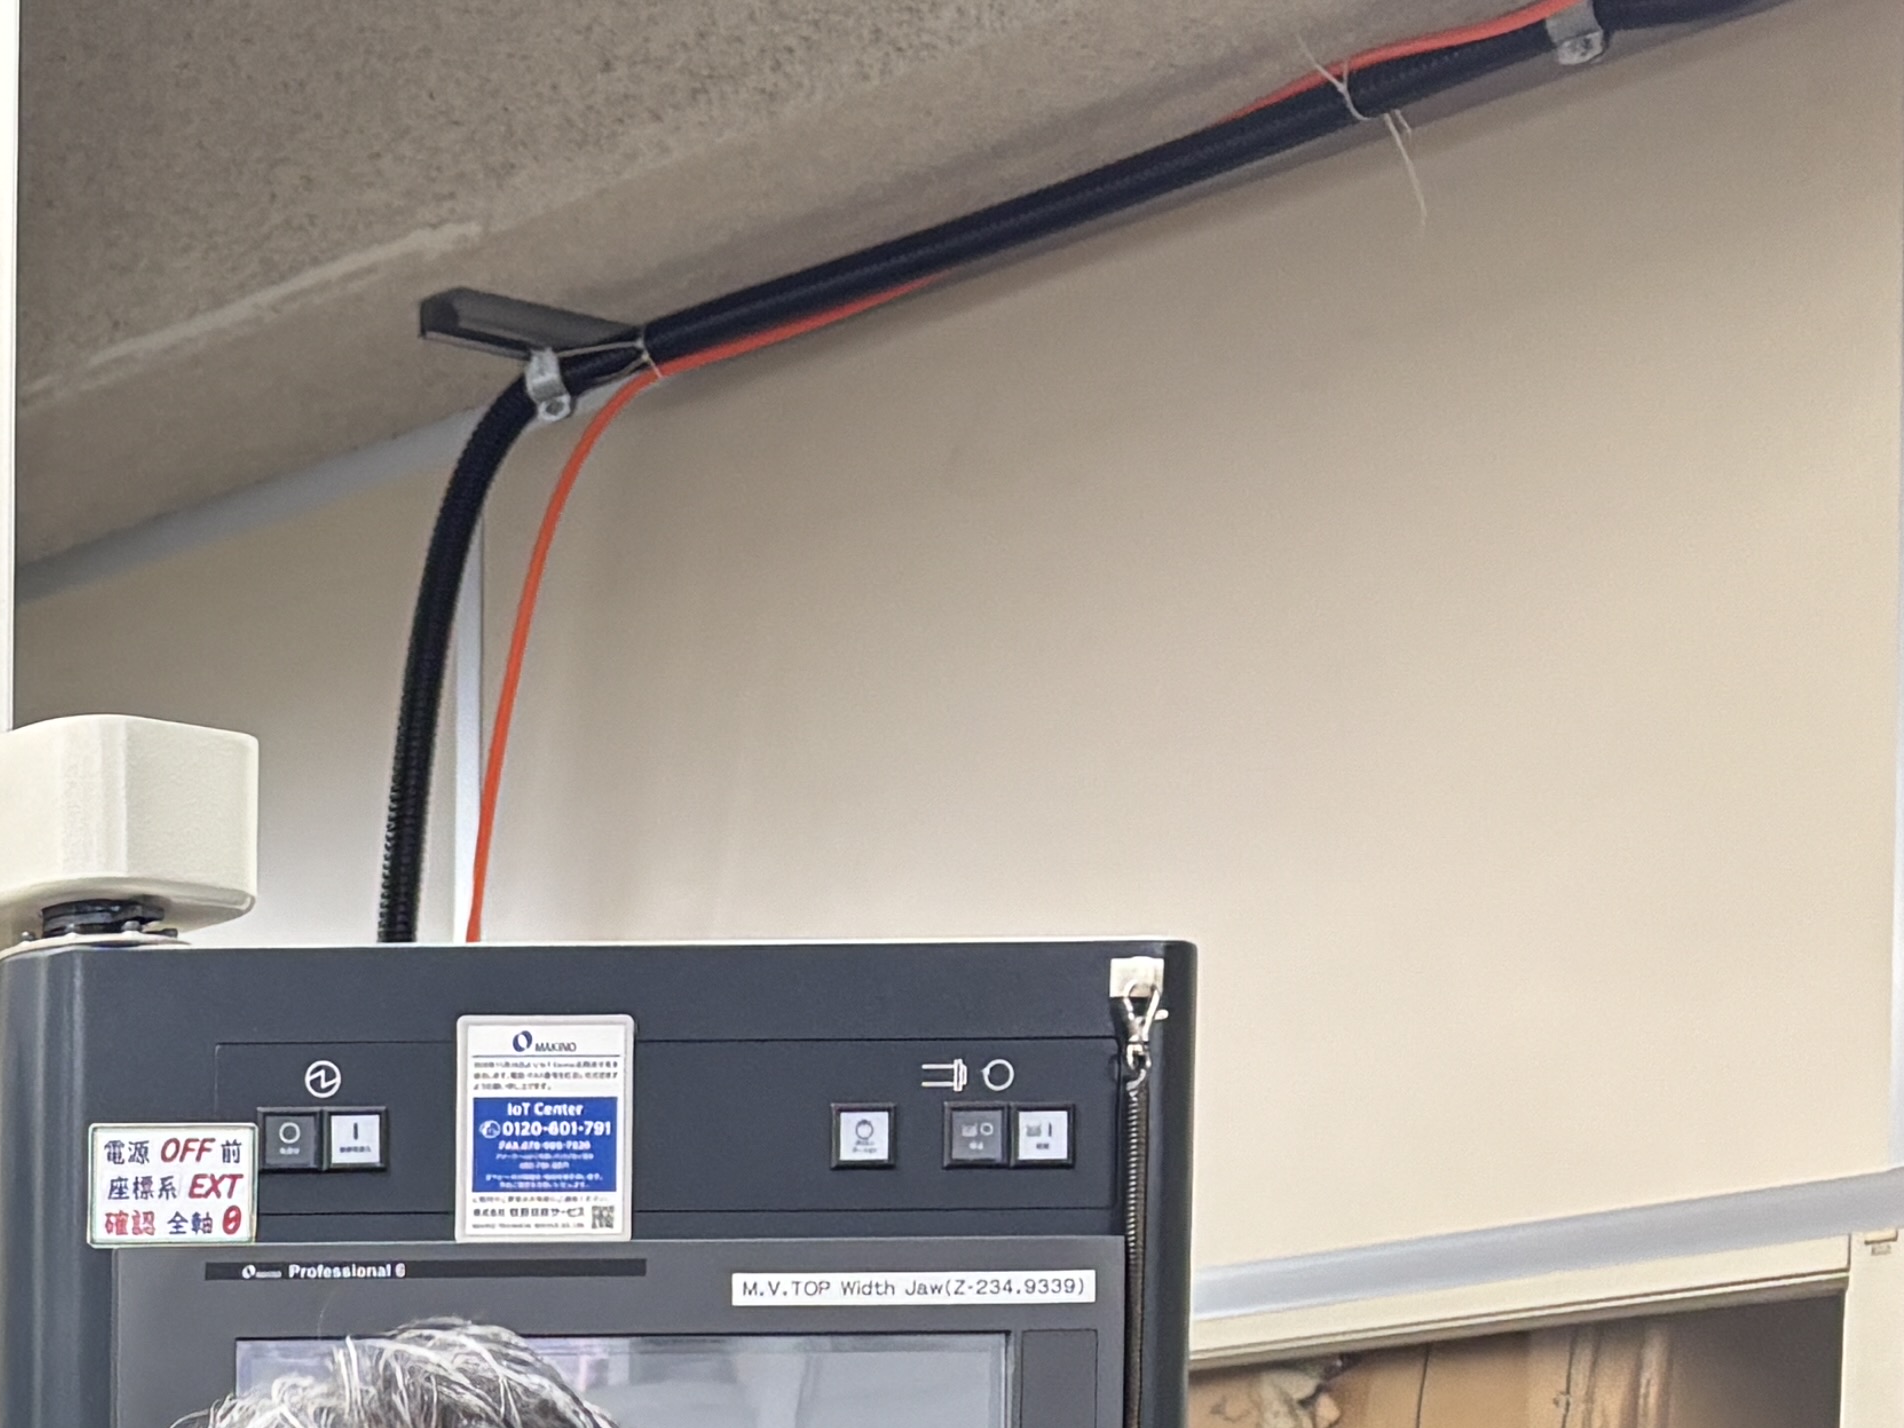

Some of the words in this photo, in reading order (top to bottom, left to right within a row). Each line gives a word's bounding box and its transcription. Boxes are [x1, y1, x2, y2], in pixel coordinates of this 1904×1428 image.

[507, 1102, 531, 1116] IoT
[534, 1103, 584, 1116] Center
[104, 1139, 150, 1165] 電源
[160, 1137, 216, 1163] OFF
[221, 1139, 242, 1164] 前
[107, 1175, 177, 1200] 座標系
[188, 1173, 244, 1199] EXT
[104, 1209, 156, 1236] 確認
[167, 1211, 213, 1235] 全軸
[288, 1262, 392, 1280] Professional
[742, 1279, 831, 1297] M.V.TOP
[840, 1278, 896, 1296] Width
